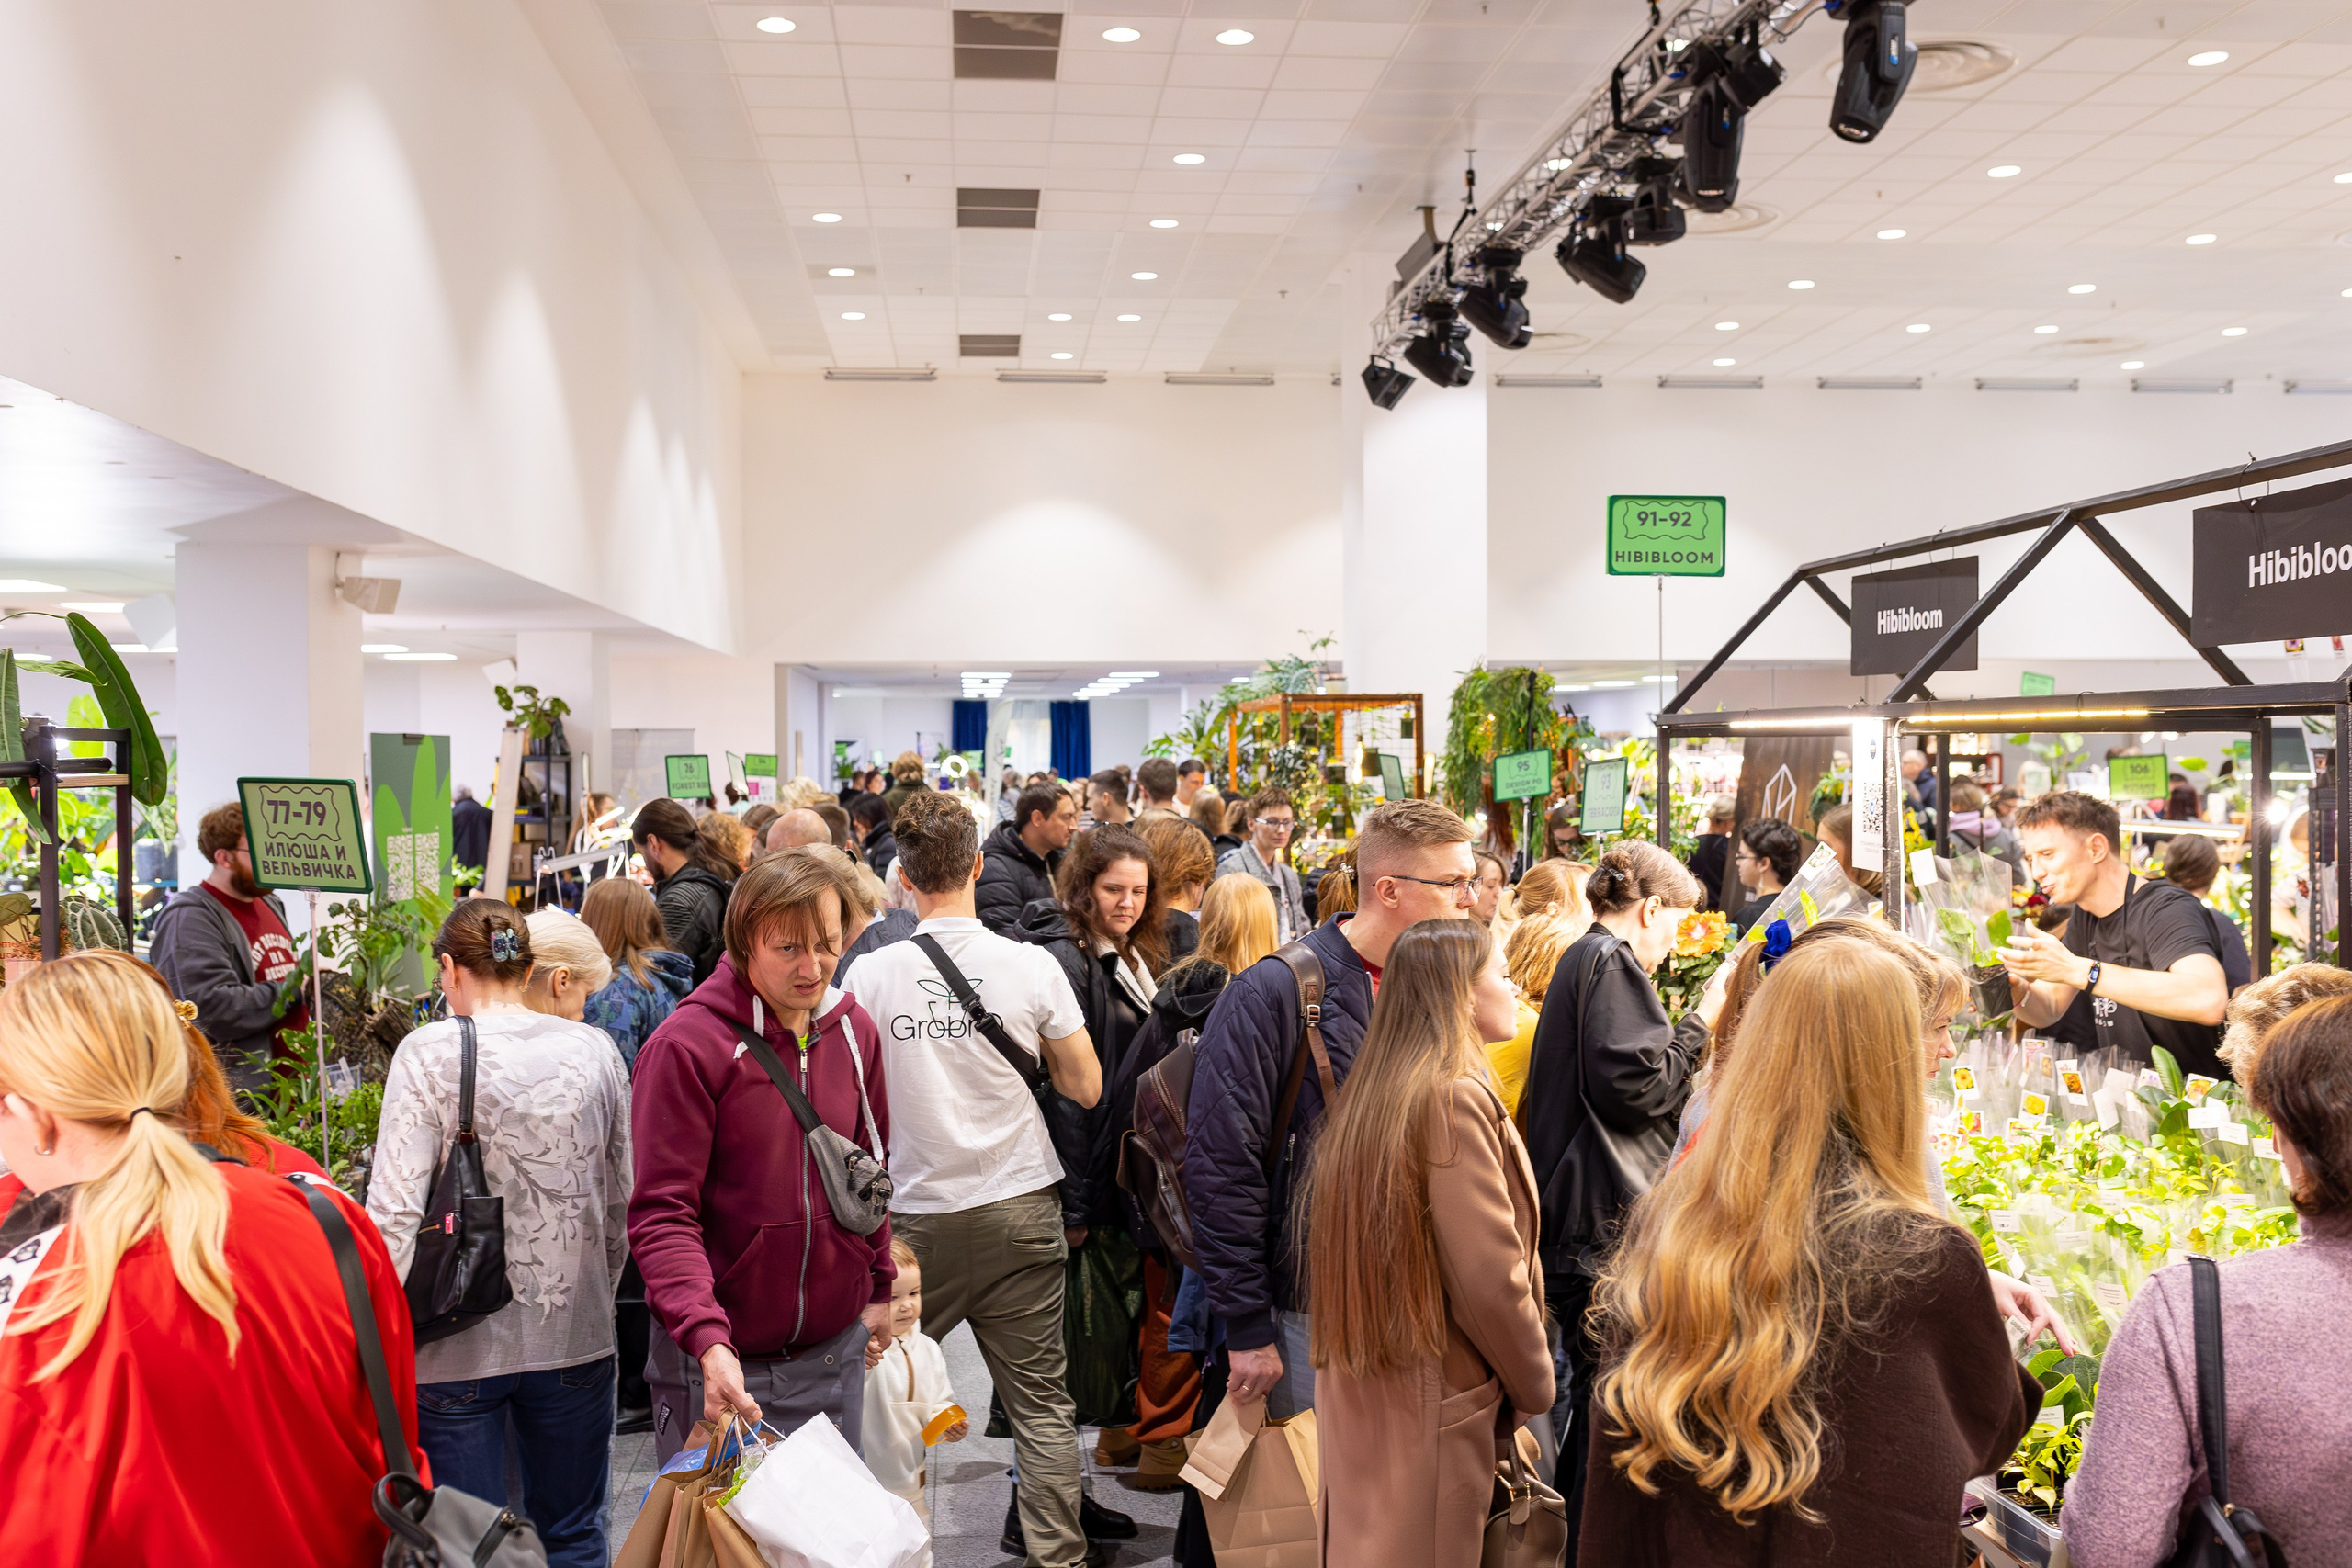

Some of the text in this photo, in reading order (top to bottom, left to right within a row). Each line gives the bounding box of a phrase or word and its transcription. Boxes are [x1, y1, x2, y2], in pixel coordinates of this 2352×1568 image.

[1636, 511, 1692, 526] 91-92
[1615, 550, 1713, 564] HIBIBLOOM
[2248, 541, 2352, 588] Hibibloo
[1877, 606, 1943, 635] Hibibloom
[1517, 761, 1530, 771] 95
[267, 799, 327, 826] 77-79
[265, 841, 346, 861] ИЛЮША И
[262, 860, 357, 880] ВЕЛЬВИЧКА
